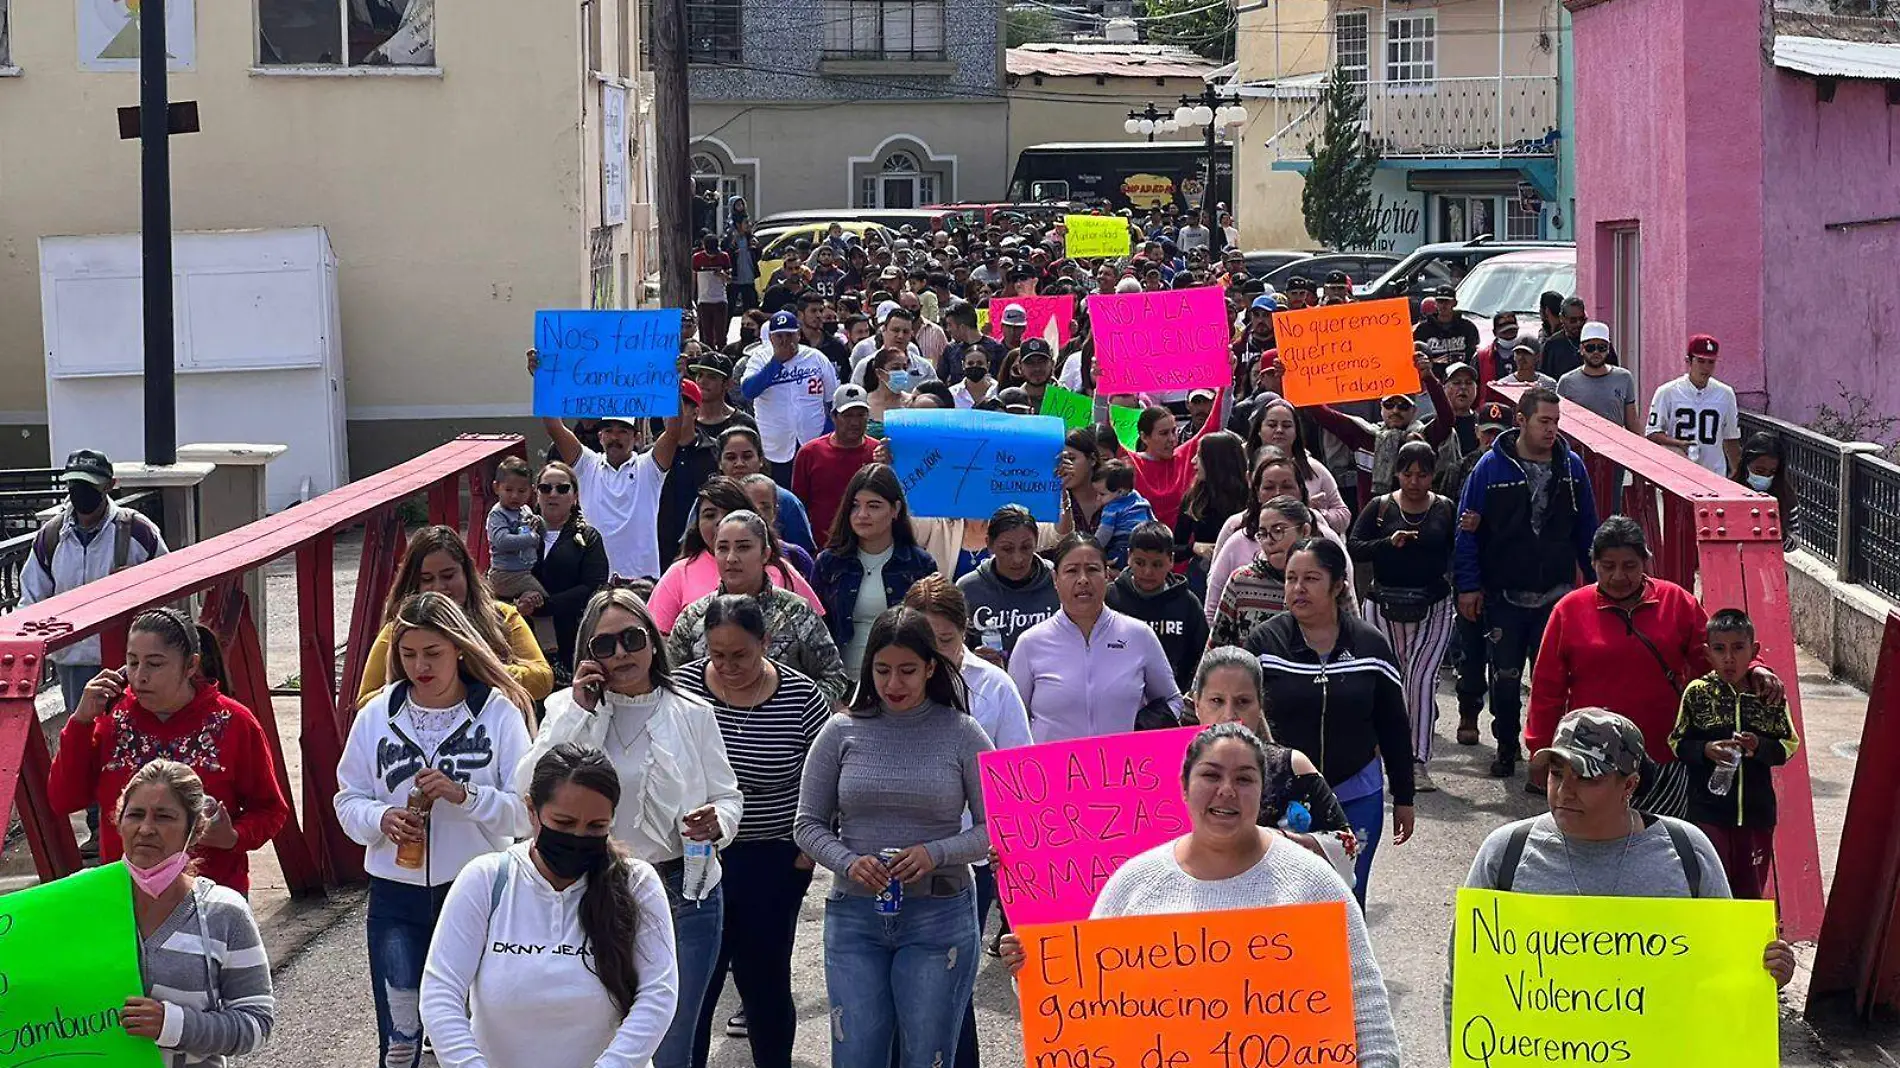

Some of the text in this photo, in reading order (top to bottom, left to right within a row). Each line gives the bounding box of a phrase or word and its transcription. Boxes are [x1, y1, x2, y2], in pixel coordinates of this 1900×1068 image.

[816, 281, 835, 297] 93
[1098, 294, 1194, 325] NO A LA
[543, 313, 680, 355] Nos faltan
[1277, 315, 1303, 338] No
[1310, 311, 1401, 347] queremos
[542, 353, 563, 386] 7
[1284, 339, 1352, 372] guerra
[1300, 355, 1381, 386] queremos
[808, 378, 824, 395] 22
[1326, 374, 1395, 397] Trabajo
[1675, 407, 1720, 445] 20
[996, 450, 1016, 464] No
[974, 605, 1051, 636] Californi
[986, 747, 1160, 804] NO A LAS
[990, 799, 1184, 853] FUERZAS
[493, 942, 546, 955] DKNY
[1473, 898, 1690, 978] No queremos
[1040, 925, 1293, 1018] El pueblo es
[1505, 970, 1645, 1015] Violencia
[1039, 979, 1332, 1044] gambucino hace
[1036, 1043, 1116, 1068] más
[1141, 1034, 1190, 1068] de
[1463, 1015, 1631, 1068] Queremos
